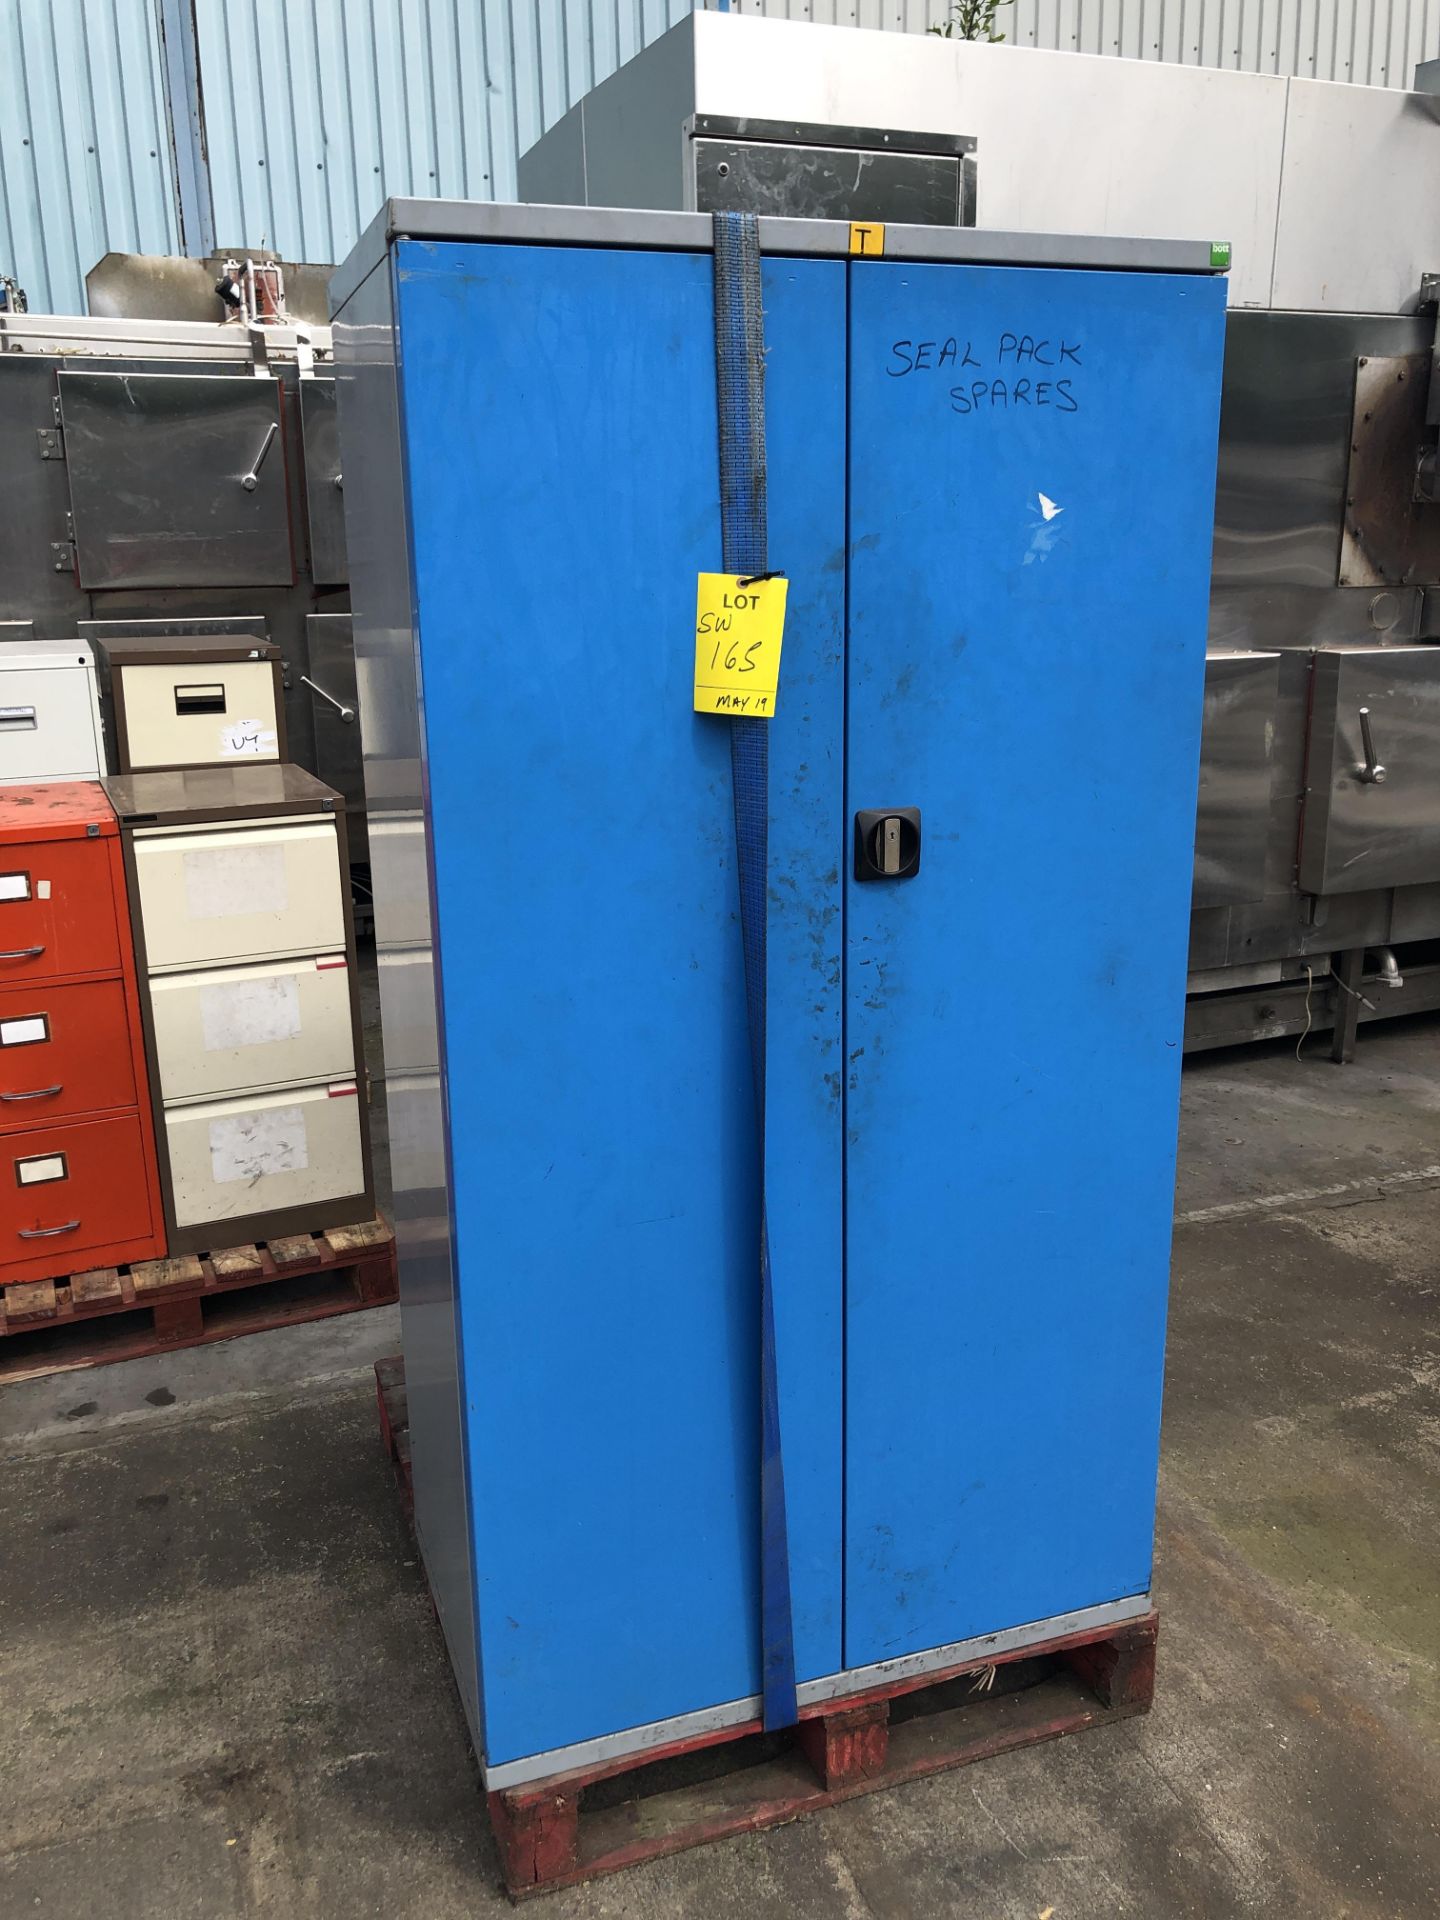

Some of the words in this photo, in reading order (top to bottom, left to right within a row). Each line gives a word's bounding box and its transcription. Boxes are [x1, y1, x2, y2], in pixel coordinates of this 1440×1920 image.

[854, 228, 872, 254] T
[886, 337, 981, 377] SEAL
[998, 333, 1082, 365] PACK
[950, 378, 1078, 413] SPARES
[723, 593, 760, 610] LOT
[697, 612, 732, 634] SW
[716, 695, 750, 712] MAY
[755, 697, 768, 712] 19
